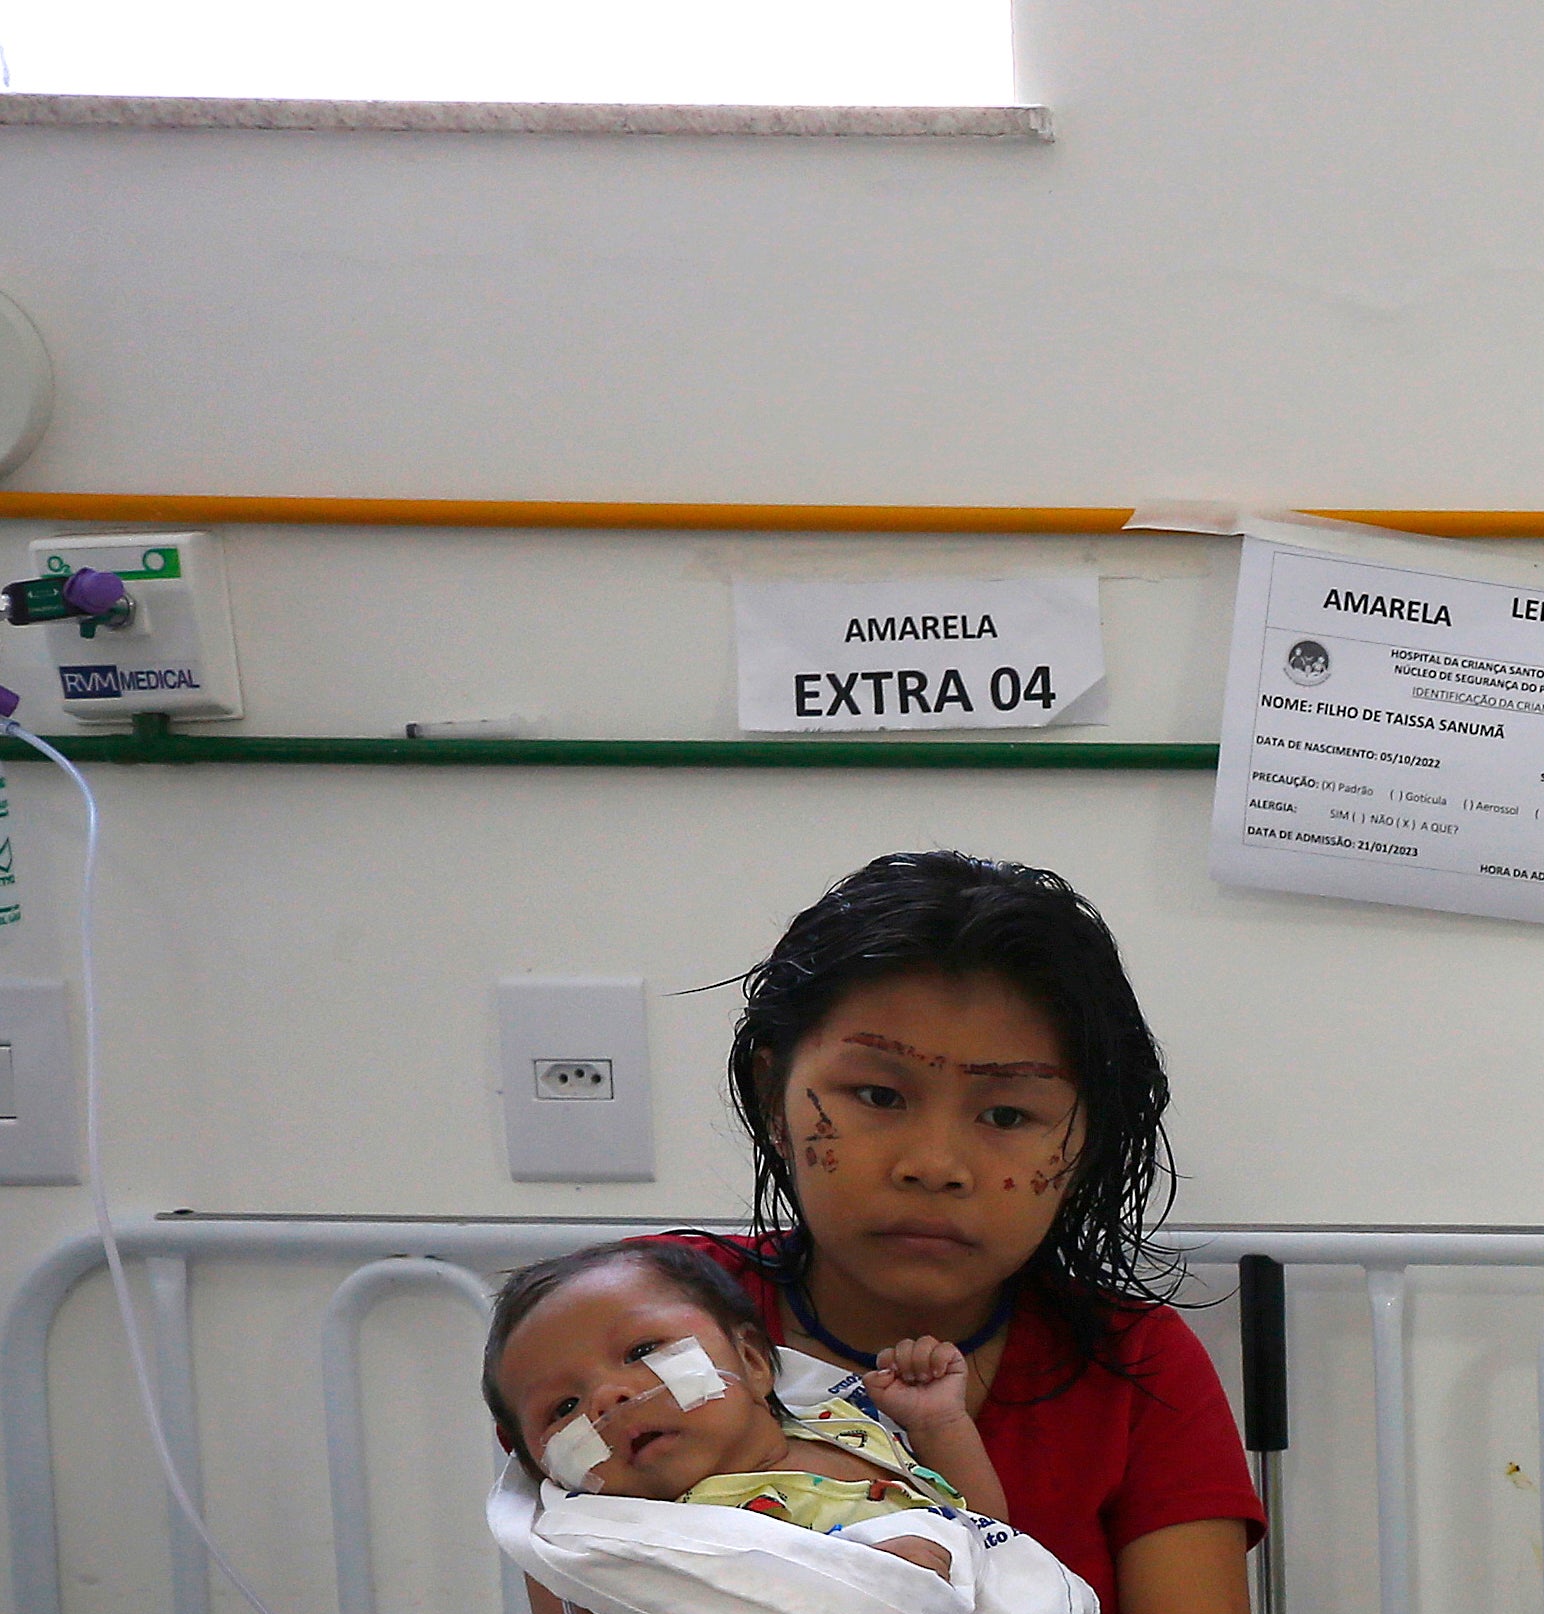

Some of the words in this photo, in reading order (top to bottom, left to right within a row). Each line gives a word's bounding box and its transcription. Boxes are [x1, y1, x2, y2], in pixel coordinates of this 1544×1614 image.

[1323, 588, 1452, 627] AMARELA
[845, 614, 998, 643] AMARELA
[1391, 649, 1442, 665] HOSPITAL
[1444, 656, 1460, 668] DA
[1461, 658, 1507, 675] CRIANÇA
[1509, 665, 1544, 680] SANTO
[1394, 664, 1437, 680] NÚCLEO
[1439, 672, 1454, 682] DE
[1455, 673, 1519, 692] SEGURANÇA
[1521, 682, 1538, 694] DO
[63, 673, 119, 693] RVM
[119, 669, 200, 691] MEDICAL
[795, 669, 974, 717] EXTRA
[990, 666, 1056, 711] 04
[1412, 686, 1497, 707] IDENTIFICAÇÃO
[1499, 698, 1516, 708] DA
[1261, 694, 1313, 714] NOME:
[1316, 702, 1359, 720] FILHO
[1362, 710, 1381, 723] DE
[1385, 711, 1435, 730] TAISSA
[1438, 718, 1506, 740] SANUMÃ
[1256, 735, 1285, 748] DATA
[1288, 740, 1302, 750] DE
[1304, 741, 1378, 761] NASCIMENTO:
[1380, 752, 1441, 769] 05/10/2022
[1252, 771, 1320, 789] PRECAUÇÃO:
[1338, 782, 1374, 797] Padrão
[1475, 801, 1519, 816] Aerossol
[1249, 798, 1298, 814] ALERGIA:
[1330, 808, 1349, 821] SIM
[1370, 813, 1394, 827] NÃO
[1431, 823, 1459, 835] QUE?
[1247, 825, 1277, 839] DATA
[1279, 830, 1293, 840] DE
[1295, 832, 1356, 849] ADMISSÃO:
[1357, 840, 1418, 857] 21/01/2023
[1480, 864, 1510, 877] HORA
[1513, 868, 1528, 880] DA
